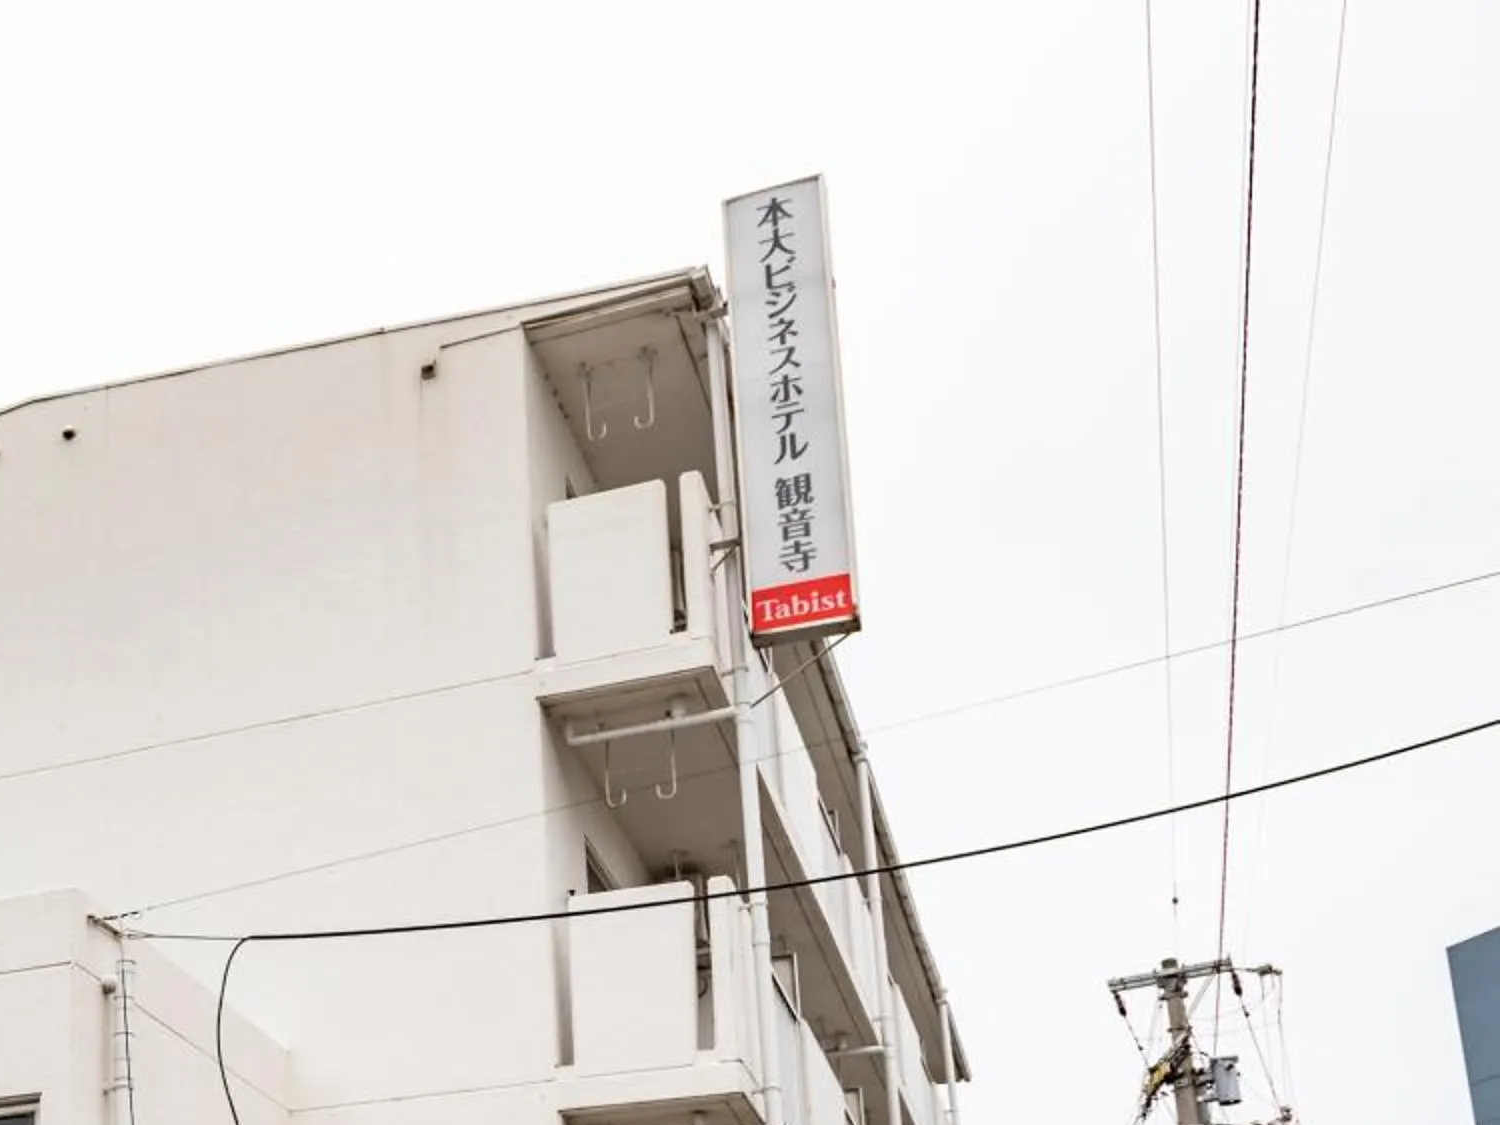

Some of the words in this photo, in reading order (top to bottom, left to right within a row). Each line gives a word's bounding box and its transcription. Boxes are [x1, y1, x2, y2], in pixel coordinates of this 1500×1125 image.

[756, 196, 809, 466] 本大ビジネスホテル
[774, 472, 817, 574] 観音寺
[755, 589, 847, 622] Tabist
